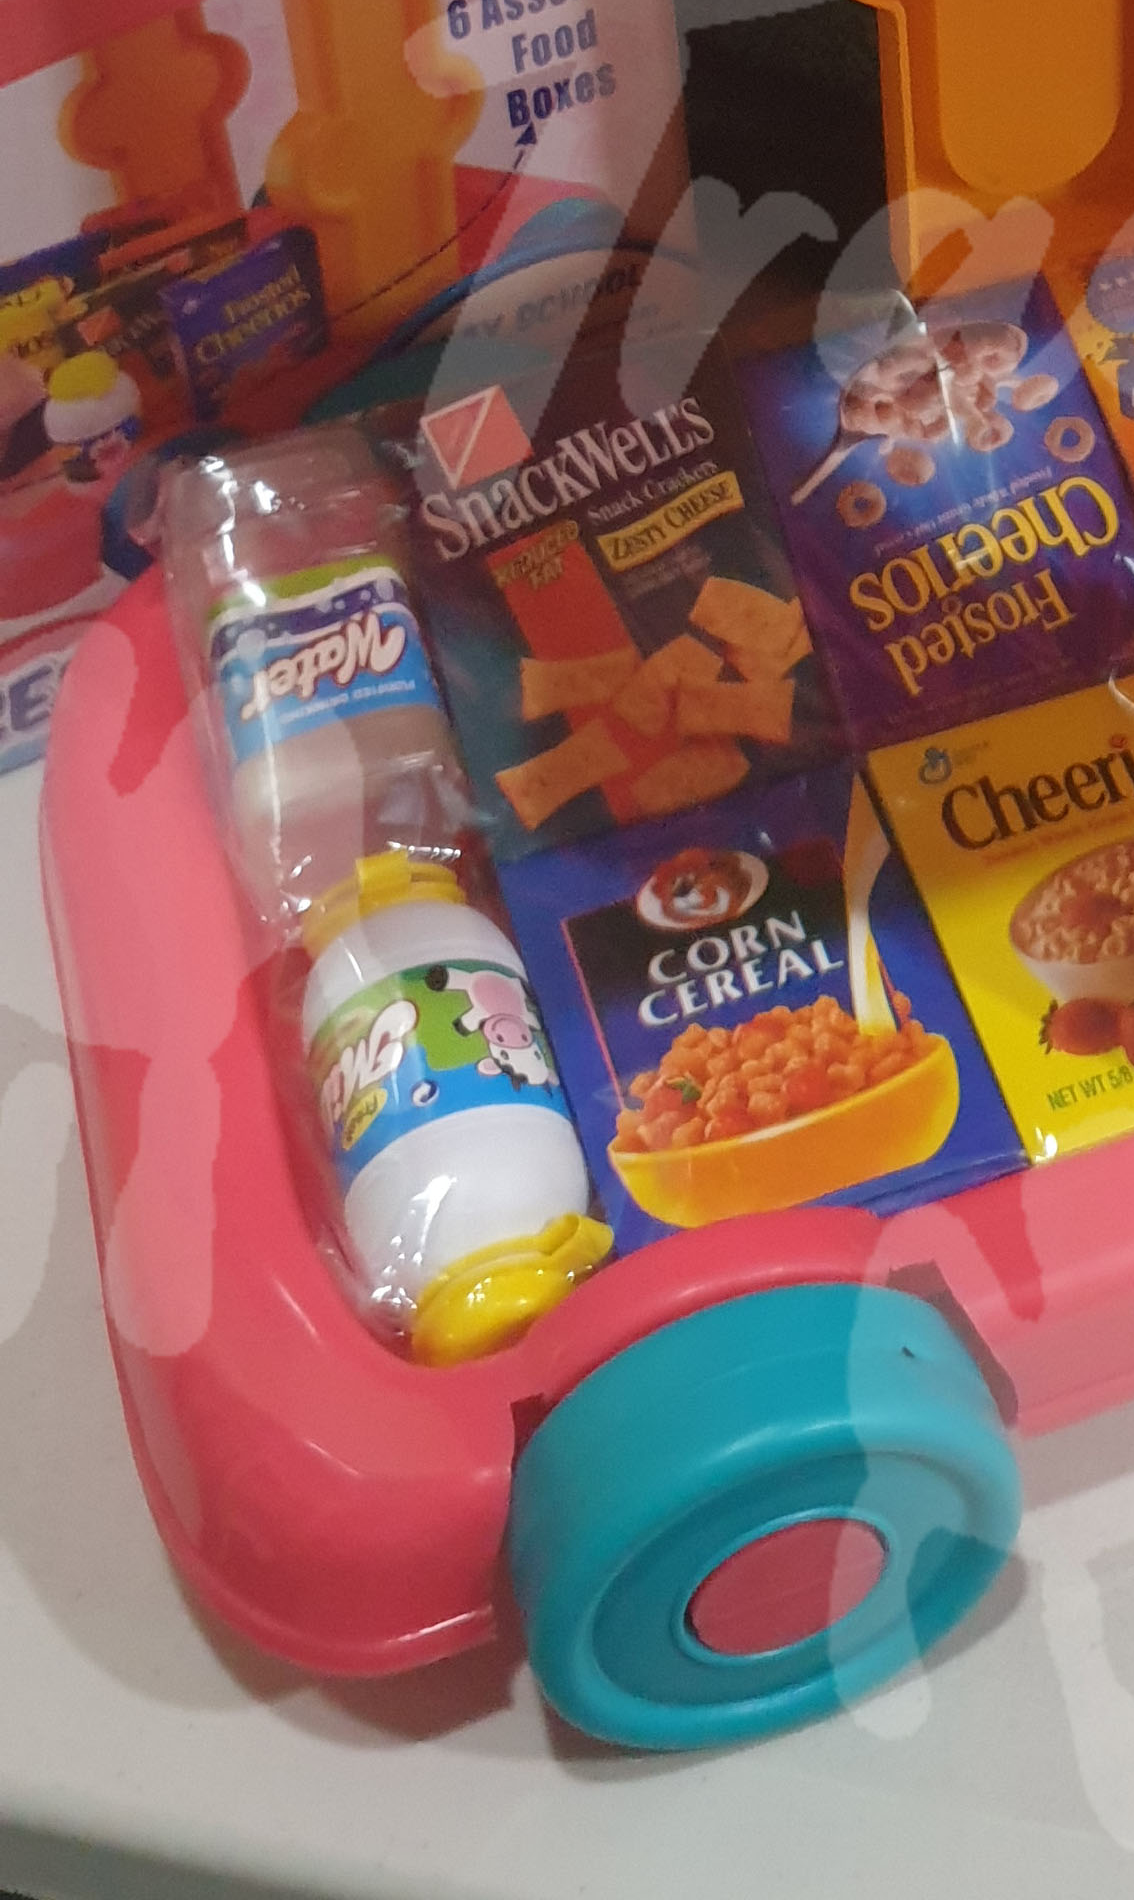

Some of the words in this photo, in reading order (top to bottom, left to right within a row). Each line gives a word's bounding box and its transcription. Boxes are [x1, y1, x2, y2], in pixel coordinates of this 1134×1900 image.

[511, 8, 598, 74] Food
[507, 63, 616, 129] Boxes
[587, 488, 645, 526] Snack
[611, 522, 670, 562] ZESTY
[663, 479, 731, 530] CHEESE
[849, 475, 1120, 633] Cheerios
[240, 609, 407, 722] Water
[886, 567, 1076, 696] Frosted
[638, 939, 844, 1028] CEREAL
[648, 910, 806, 986] CORN
[1046, 1083, 1078, 1111] NET
[1078, 1072, 1107, 1099] WT
